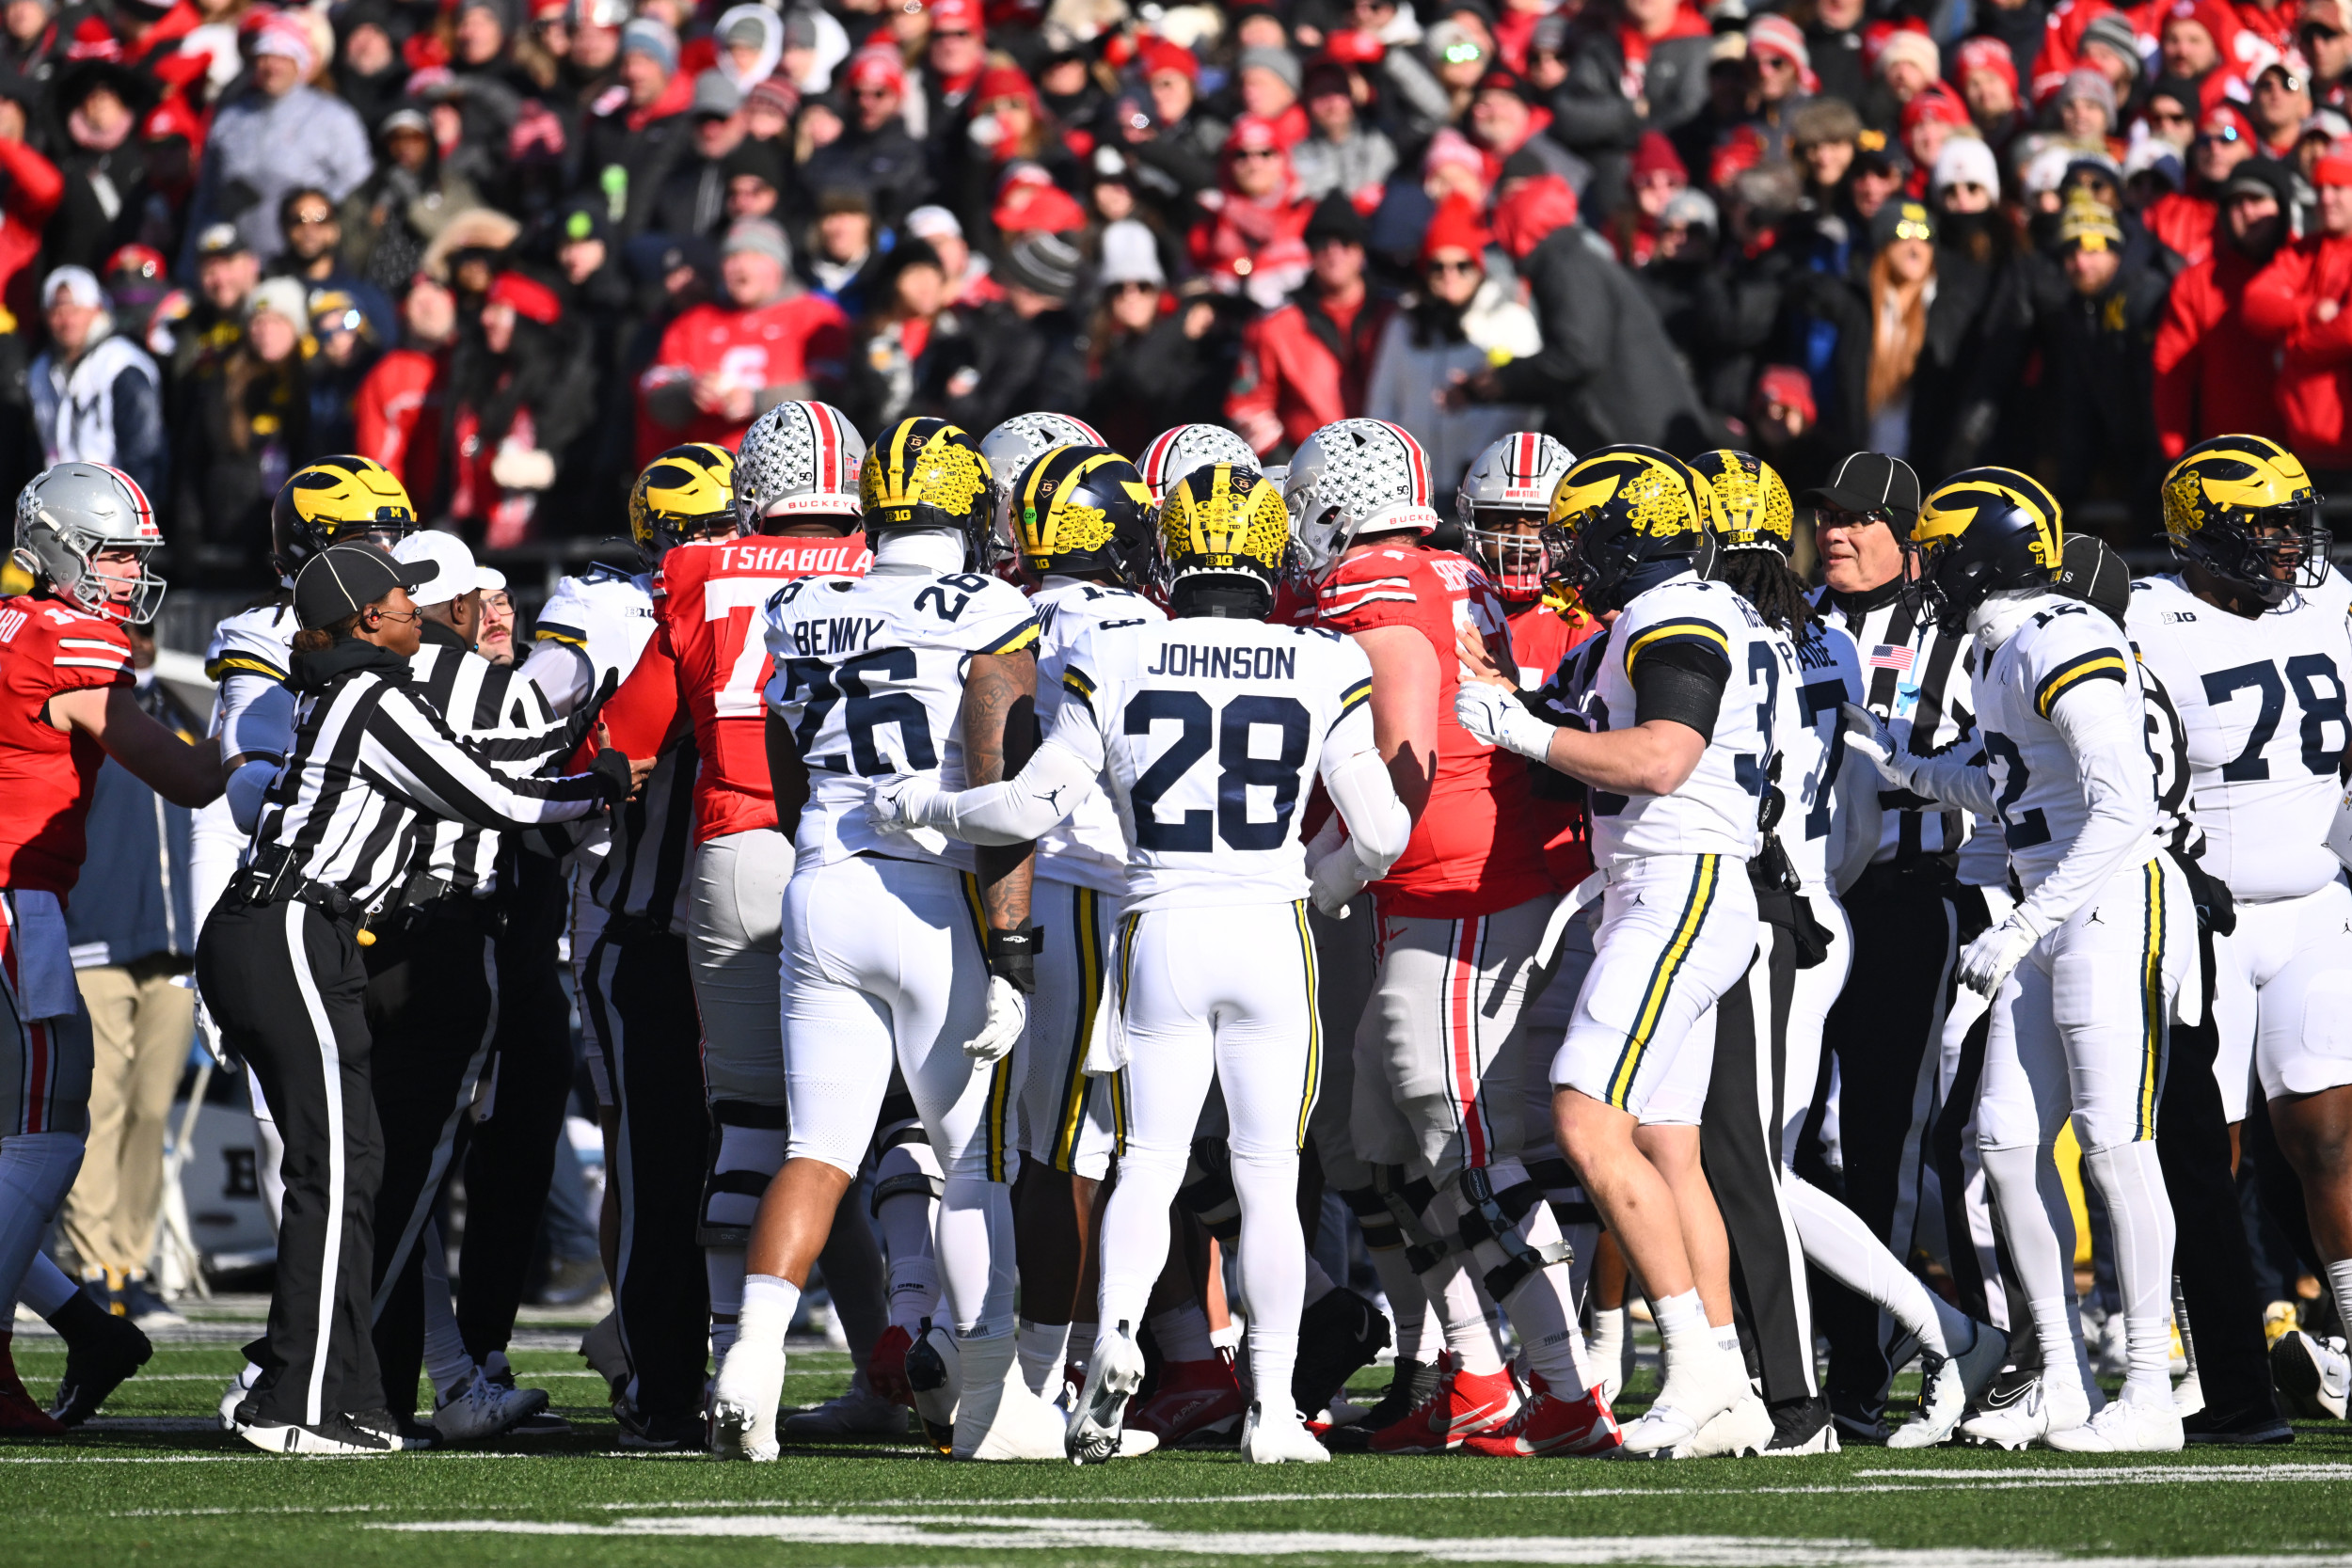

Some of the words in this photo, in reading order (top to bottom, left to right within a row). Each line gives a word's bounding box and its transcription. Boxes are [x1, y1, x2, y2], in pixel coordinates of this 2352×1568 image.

[1529, 489, 1546, 499] STATE
[2302, 488, 2311, 499] M
[390, 508, 402, 517] M
[721, 546, 874, 573] TSHABOLA
[1179, 541, 1191, 551] 28
[2035, 553, 2044, 564] 12
[2062, 571, 2074, 583] S
[914, 574, 990, 623] 26
[2031, 603, 2089, 629] 12
[793, 617, 885, 656] BENNY
[1148, 643, 1296, 679] JOHNSON
[1775, 635, 1838, 675] PAIGE
[780, 646, 939, 778] 26
[2201, 652, 2352, 783] 78
[1123, 689, 1311, 853] 28
[1795, 678, 1850, 842] 7
[1172, 1399, 1202, 1426] ALPHA
